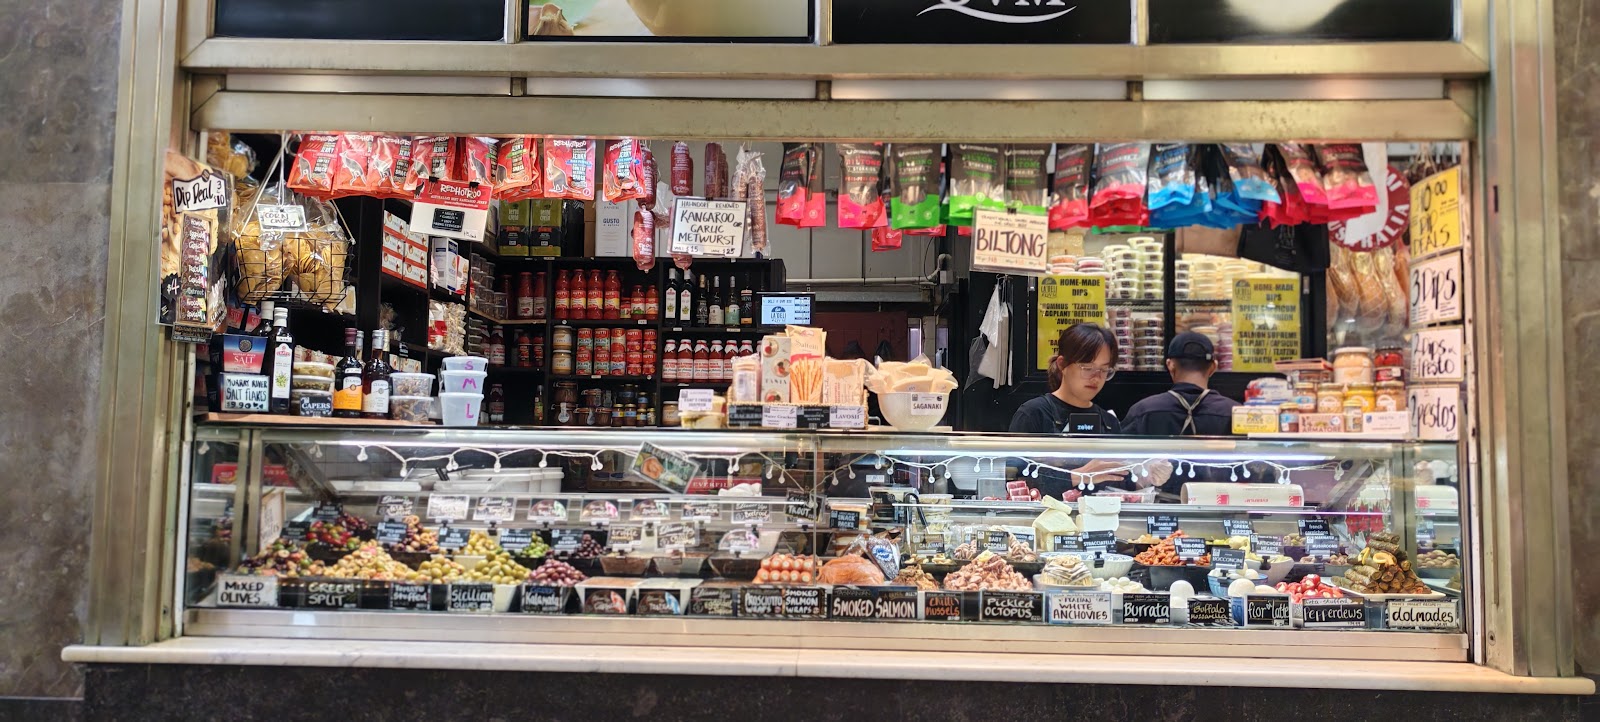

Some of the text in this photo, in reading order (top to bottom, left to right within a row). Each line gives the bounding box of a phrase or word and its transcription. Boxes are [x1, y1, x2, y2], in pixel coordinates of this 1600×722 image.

[176, 180, 221, 207] Dip Deal 3
[440, 184, 481, 199] REDHOTROO
[214, 195, 225, 206] $10
[680, 210, 735, 224] KANGAROO
[691, 224, 724, 233] GARLIC
[678, 232, 736, 246] METWURST
[977, 229, 1046, 258] BILTONG
[1413, 223, 1450, 256] DEALS
[167, 278, 179, 294] $4
[1412, 270, 1420, 306] 3
[234, 356, 255, 365] SALT
[464, 361, 474, 370] S
[462, 378, 477, 389] M
[226, 388, 242, 400] SALT
[467, 403, 474, 419] L
[788, 506, 810, 517] TROUT
[225, 582, 264, 591] MIXED
[309, 582, 354, 593] GREEN
[220, 591, 260, 604] OLIVES
[452, 589, 492, 601] Sicilian
[526, 592, 559, 606] Kalamata
[786, 597, 818, 605] SALMON
[785, 605, 812, 613] WRAPS
[833, 597, 915, 618] SMOKED SALMON
[988, 598, 1034, 608] Pickled
[985, 607, 1033, 617] OCTOPUS
[1053, 609, 1108, 620] ANCHOVIES
[1124, 602, 1169, 618] Burrata
[1193, 605, 1226, 615] Buffalo
[1392, 605, 1454, 623] dolmades
